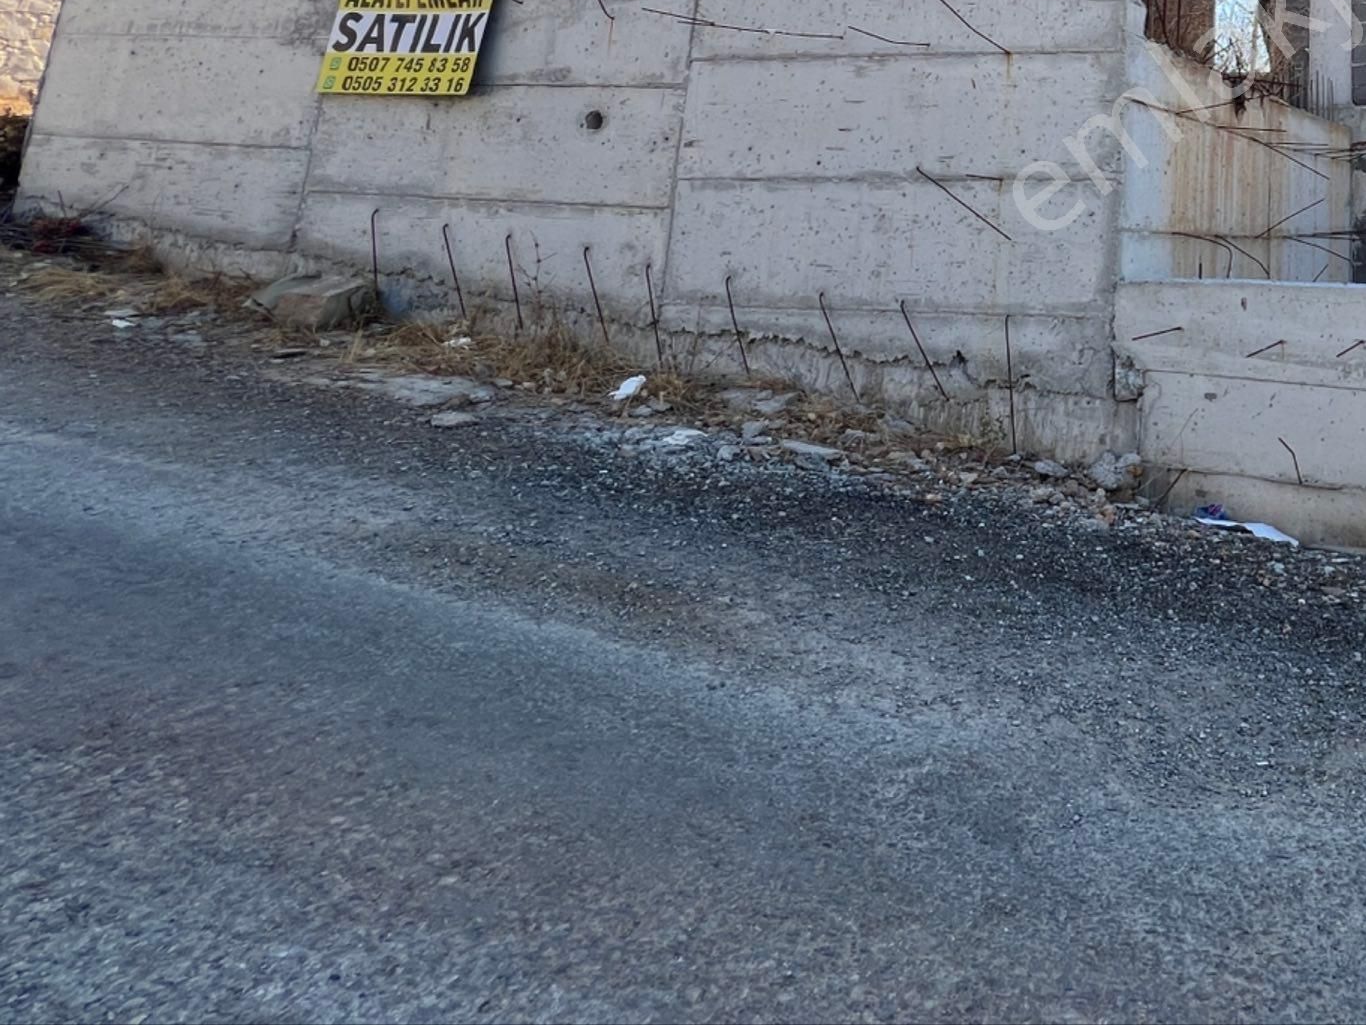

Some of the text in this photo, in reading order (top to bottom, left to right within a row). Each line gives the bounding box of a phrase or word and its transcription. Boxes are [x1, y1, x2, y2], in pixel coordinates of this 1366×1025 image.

[332, 12, 487, 53] SATILIK
[348, 57, 471, 73] 0507 745 83 58
[342, 76, 464, 92] 0505 312 33 16
